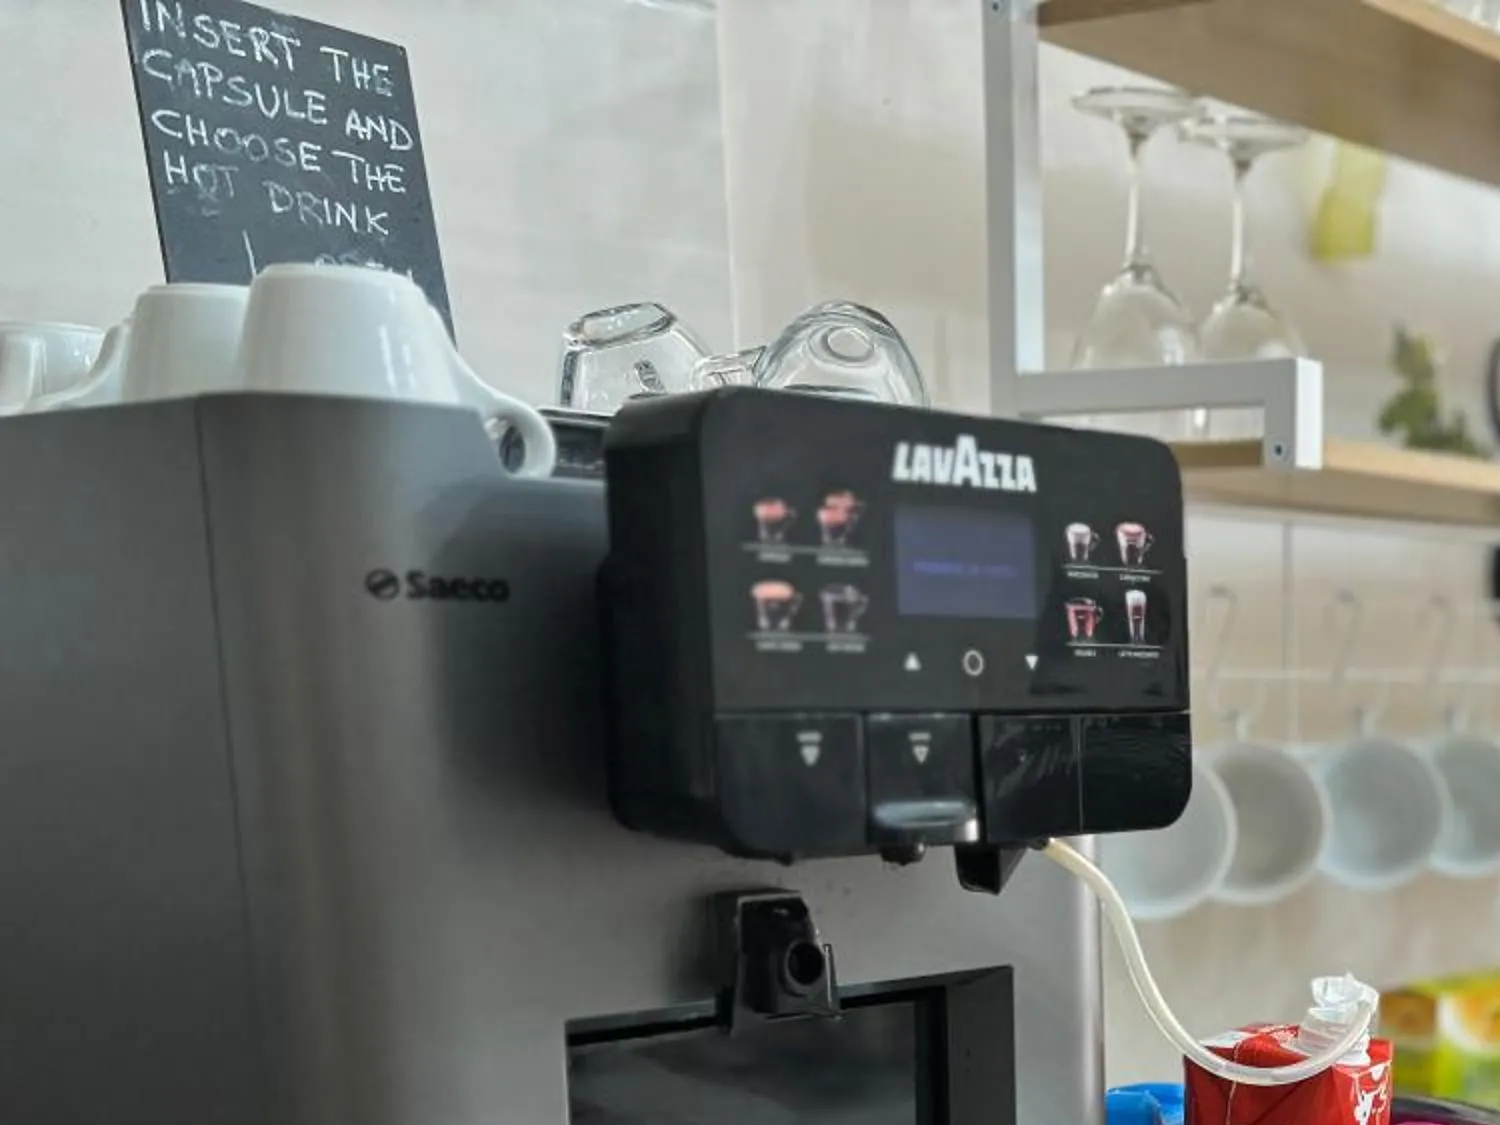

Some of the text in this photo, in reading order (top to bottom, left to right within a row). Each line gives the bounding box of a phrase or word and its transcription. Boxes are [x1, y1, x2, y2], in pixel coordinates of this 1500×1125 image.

[140, 0, 393, 97] INSERT THE
[141, 49, 414, 151] CAPSULE AND
[150, 108, 406, 193] CHOOSE THE
[162, 150, 389, 235] HOT DRINK
[892, 435, 1037, 493] LAVAZZA
[405, 569, 510, 602] Saeco
